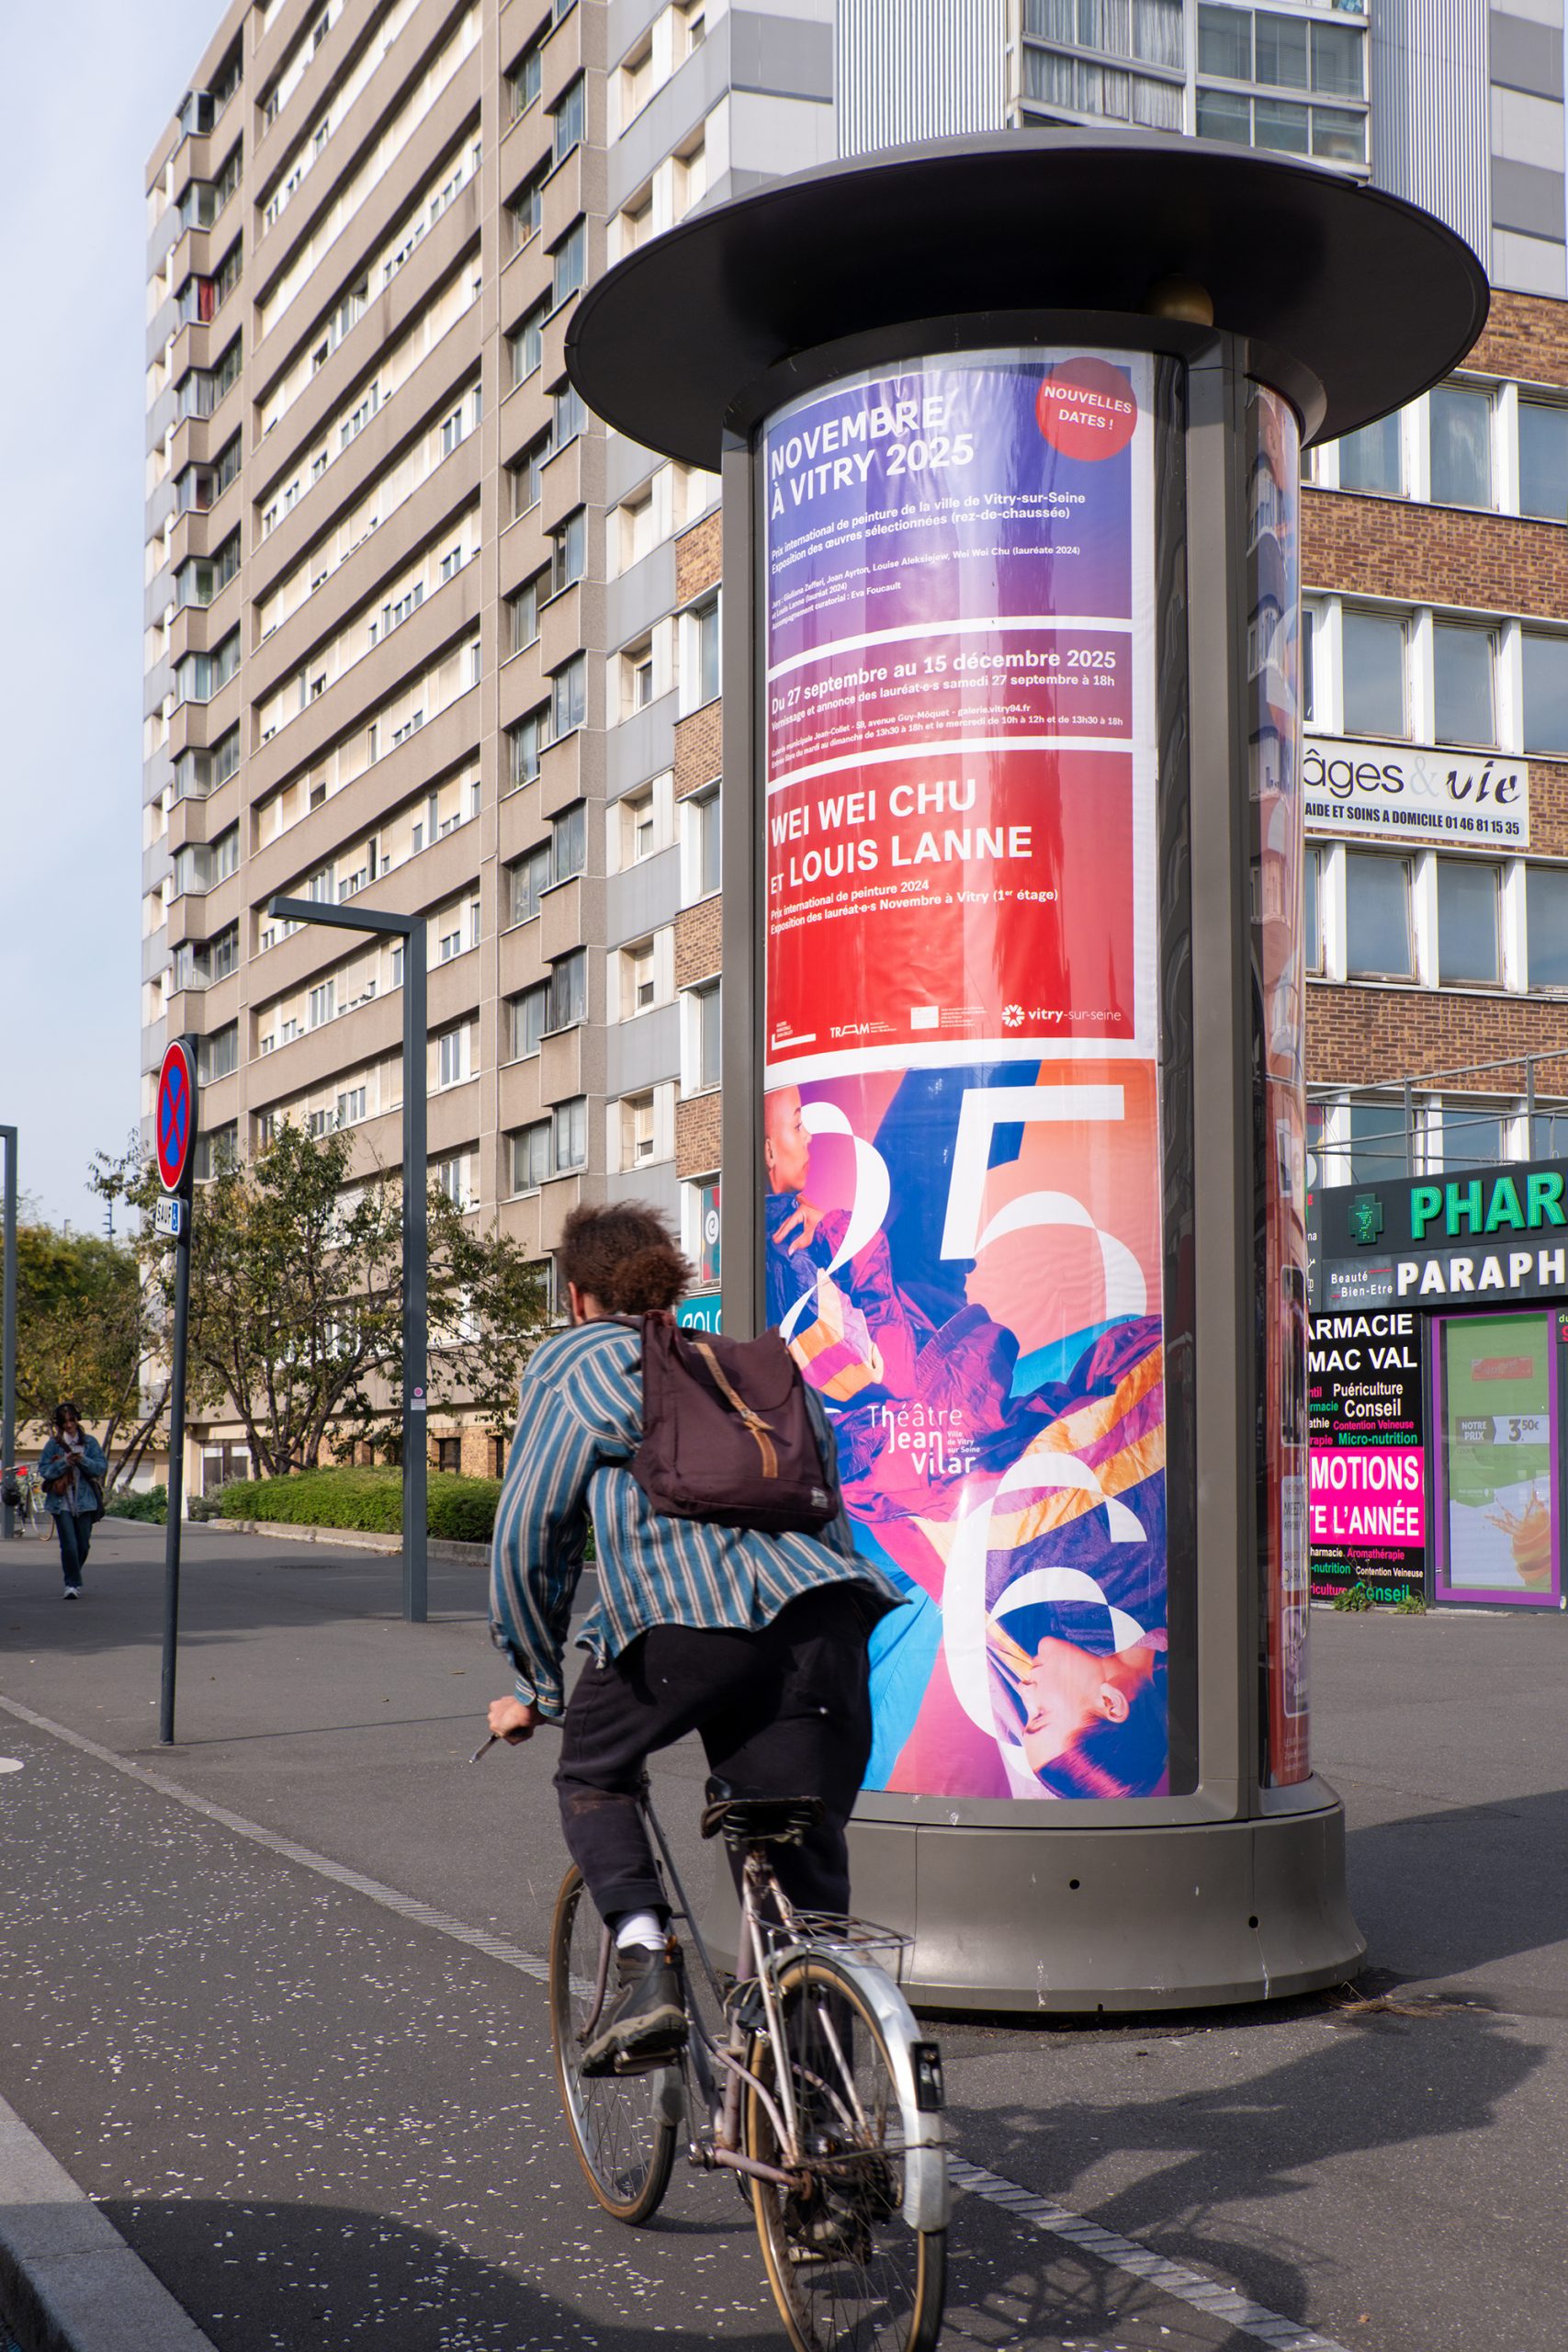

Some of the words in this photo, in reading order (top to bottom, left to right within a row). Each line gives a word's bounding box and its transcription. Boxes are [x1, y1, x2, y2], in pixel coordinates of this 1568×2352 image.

[1044, 386, 1132, 414] NOUVELLES
[1058, 409, 1106, 428] DATES
[1109, 419, 1113, 430] !
[772, 395, 943, 480] NOVEMBRE
[771, 481, 784, 521] À
[790, 448, 876, 505] VITRY
[886, 433, 974, 476] 2025
[772, 547, 784, 561] Prix
[784, 522, 834, 553] international
[837, 518, 849, 531] de
[852, 508, 897, 528] peinture
[901, 503, 916, 515] de
[919, 502, 930, 512] la
[934, 498, 960, 510] ville
[964, 496, 979, 506] de
[984, 492, 1086, 507] Vitry-sur-Seine
[772, 548, 806, 574] Exposition
[807, 542, 823, 555] des
[825, 531, 863, 548] œuvres
[865, 513, 947, 537] sélectionnées
[952, 507, 1070, 524] (rez-de-chaussée)
[827, 573, 843, 584] Joan
[844, 566, 871, 580] Ayrton,
[873, 560, 899, 571] Louise
[953, 548, 970, 559] Wei
[972, 548, 988, 557] Wei
[991, 548, 1010, 556] Chu
[1012, 546, 1054, 557] (lauréate
[1055, 546, 1080, 556] 2024)
[815, 594, 846, 610] curatorial
[852, 588, 865, 599] Eva
[866, 582, 901, 595] Foucault
[829, 582, 847, 594] 2024)
[772, 697, 784, 715] Du
[787, 685, 801, 707] 27
[804, 667, 887, 699] septembre
[893, 662, 917, 678] au
[923, 655, 947, 674] 15
[953, 650, 1060, 671] décembre
[1066, 650, 1116, 668] 2025
[772, 711, 806, 731] Vernissage
[807, 705, 815, 716] et
[817, 696, 855, 713] annonce
[858, 691, 876, 702] des
[943, 675, 988, 689] samedi
[991, 674, 1007, 686] 27
[1010, 673, 1078, 687] septembre
[1082, 674, 1089, 685] à
[1093, 675, 1115, 686] 18h
[814, 725, 850, 740] Jean-Collet
[868, 717, 896, 728] avenue
[898, 709, 950, 725] Guy-Môquet
[958, 704, 1031, 717] galerie.vitry94.fr
[795, 748, 803, 758] du
[804, 743, 819, 755] mardi
[821, 741, 829, 750] au
[829, 733, 863, 748] dimanche
[864, 730, 874, 740] de
[876, 727, 899, 738] 13h30
[901, 724, 907, 733] à
[908, 723, 923, 733] 18h
[925, 721, 933, 730] et
[936, 720, 943, 729] le
[946, 717, 985, 728] mercredi
[987, 717, 998, 725] de
[1002, 716, 1017, 725] 10h
[1020, 715, 1025, 724] à
[1028, 715, 1044, 724] 12h
[1046, 716, 1055, 724] et
[1058, 715, 1069, 724] de
[1072, 715, 1098, 725] 13h30
[1100, 716, 1106, 725] à
[1108, 717, 1123, 726] 18h
[1303, 748, 1404, 798] âges
[1446, 761, 1521, 804] vie
[771, 805, 809, 847] WEI
[818, 789, 876, 831] WEI
[889, 779, 976, 817] CHU
[1305, 802, 1330, 818] AIDE
[1332, 804, 1345, 818] ET
[1348, 807, 1380, 822] SOINS
[1382, 810, 1391, 823] A
[1393, 810, 1443, 828] DOMICILE
[1446, 816, 1458, 830] 01
[1460, 817, 1474, 831] 46
[1476, 819, 1489, 832] 81
[1492, 820, 1503, 834] 15
[1505, 820, 1520, 835] 35
[770, 873, 784, 894] ET
[790, 839, 878, 888] LOUIS
[891, 826, 1032, 867] LANNE
[770, 907, 783, 921] Prix
[784, 893, 834, 917] international
[836, 889, 849, 901] de
[851, 884, 897, 902] peinture
[900, 879, 930, 892] 2024
[770, 915, 806, 935] Exposition
[807, 910, 822, 922] des
[879, 894, 942, 910] Novembre
[944, 893, 953, 904] à
[957, 890, 988, 905] Vitry
[1017, 888, 1058, 905] étage)
[1029, 1008, 1122, 1023] vitry-sur-seine
[830, 1023, 870, 1038] TRAM
[157, 1204, 171, 1224] SAUF
[1411, 1171, 1567, 1239] PHAR
[1331, 1271, 1368, 1284] Beauté
[1397, 1249, 1565, 1296] PARAPH
[1341, 1284, 1393, 1297] Bien-Etre
[1308, 1349, 1361, 1373] MAC
[1368, 1346, 1417, 1369] VAL
[1333, 1381, 1404, 1397] Puériculture
[867, 1403, 963, 1429] Théâtre
[1344, 1397, 1402, 1418] Conseil
[1333, 1420, 1376, 1430] Contention
[1378, 1419, 1415, 1430] Veineuse
[1338, 1431, 1418, 1446] Micro-nutrition
[1461, 1421, 1487, 1430] NOTRE
[1464, 1431, 1485, 1441] PRIX
[888, 1430, 943, 1453] Jean
[956, 1438, 975, 1447] Vitry
[911, 1452, 976, 1475] Vilar
[1311, 1455, 1419, 1491] MOTIONS
[1333, 1499, 1419, 1536] L'ANNÉE
[1347, 1548, 1404, 1562] Aromathérapie
[1356, 1566, 1392, 1577] Contention
[1393, 1567, 1424, 1578] Veineuse
